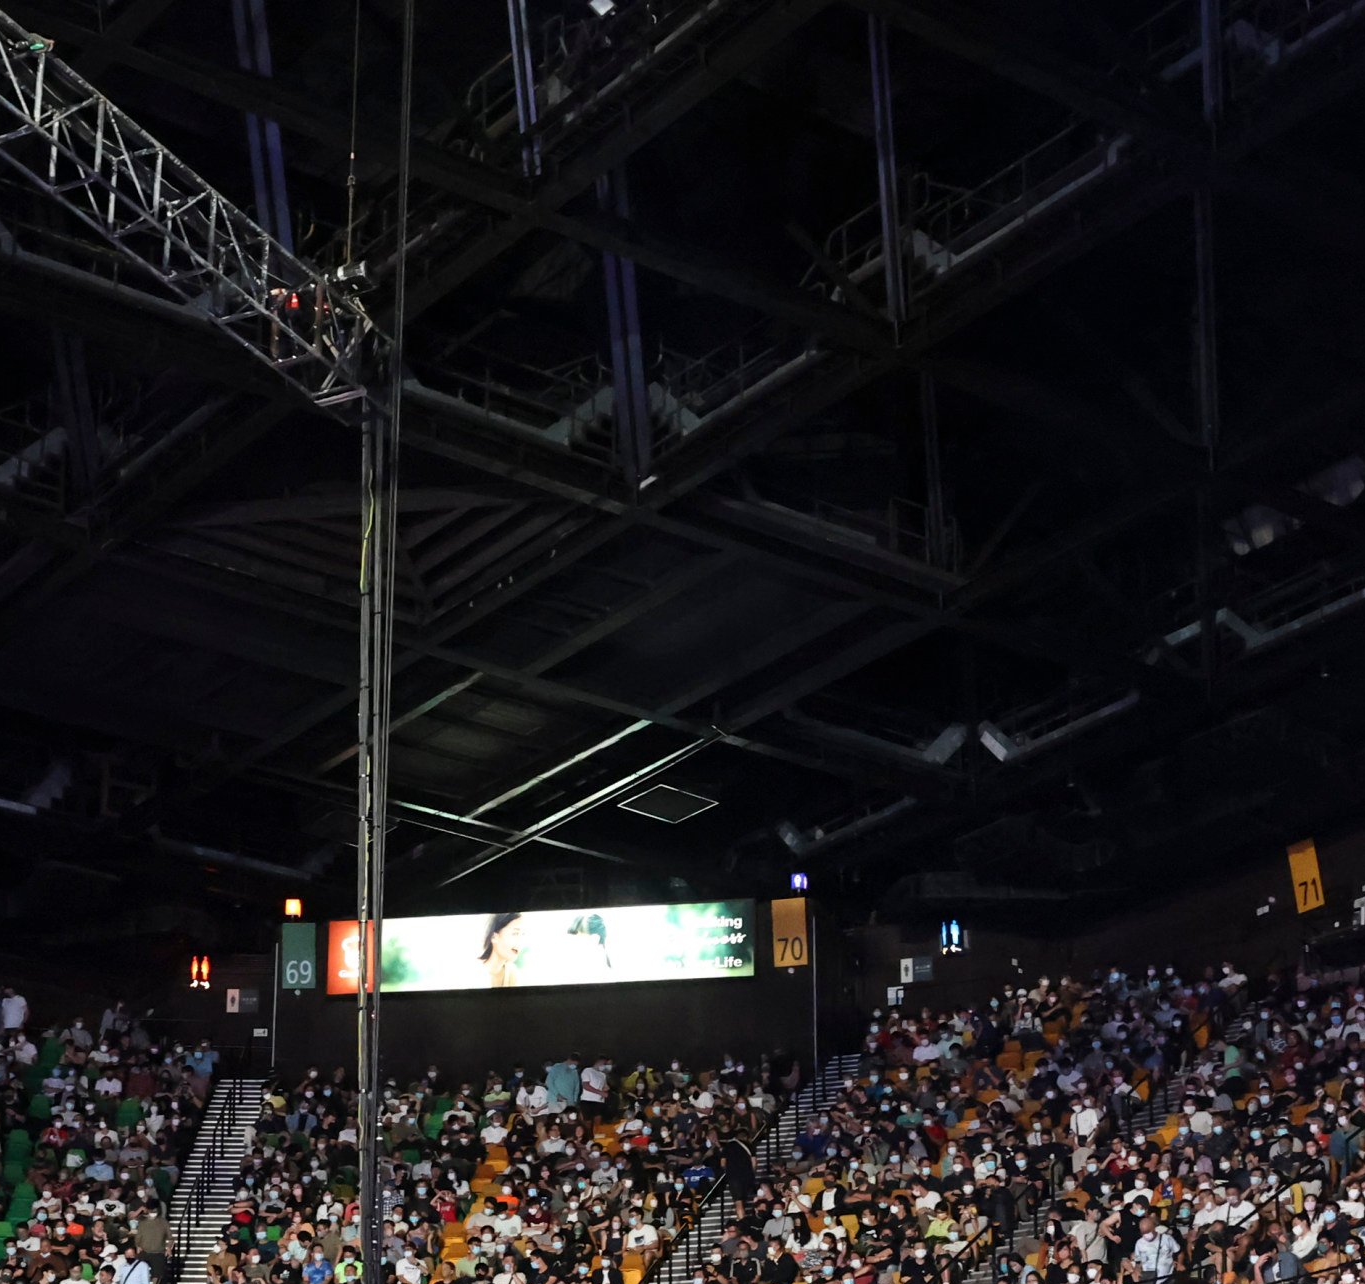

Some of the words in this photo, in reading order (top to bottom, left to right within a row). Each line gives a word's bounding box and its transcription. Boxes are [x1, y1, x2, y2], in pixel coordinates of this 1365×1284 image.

[1297, 878, 1320, 904] 71
[715, 956, 743, 968] Life
[777, 936, 804, 962] 70
[285, 958, 313, 985] 69
